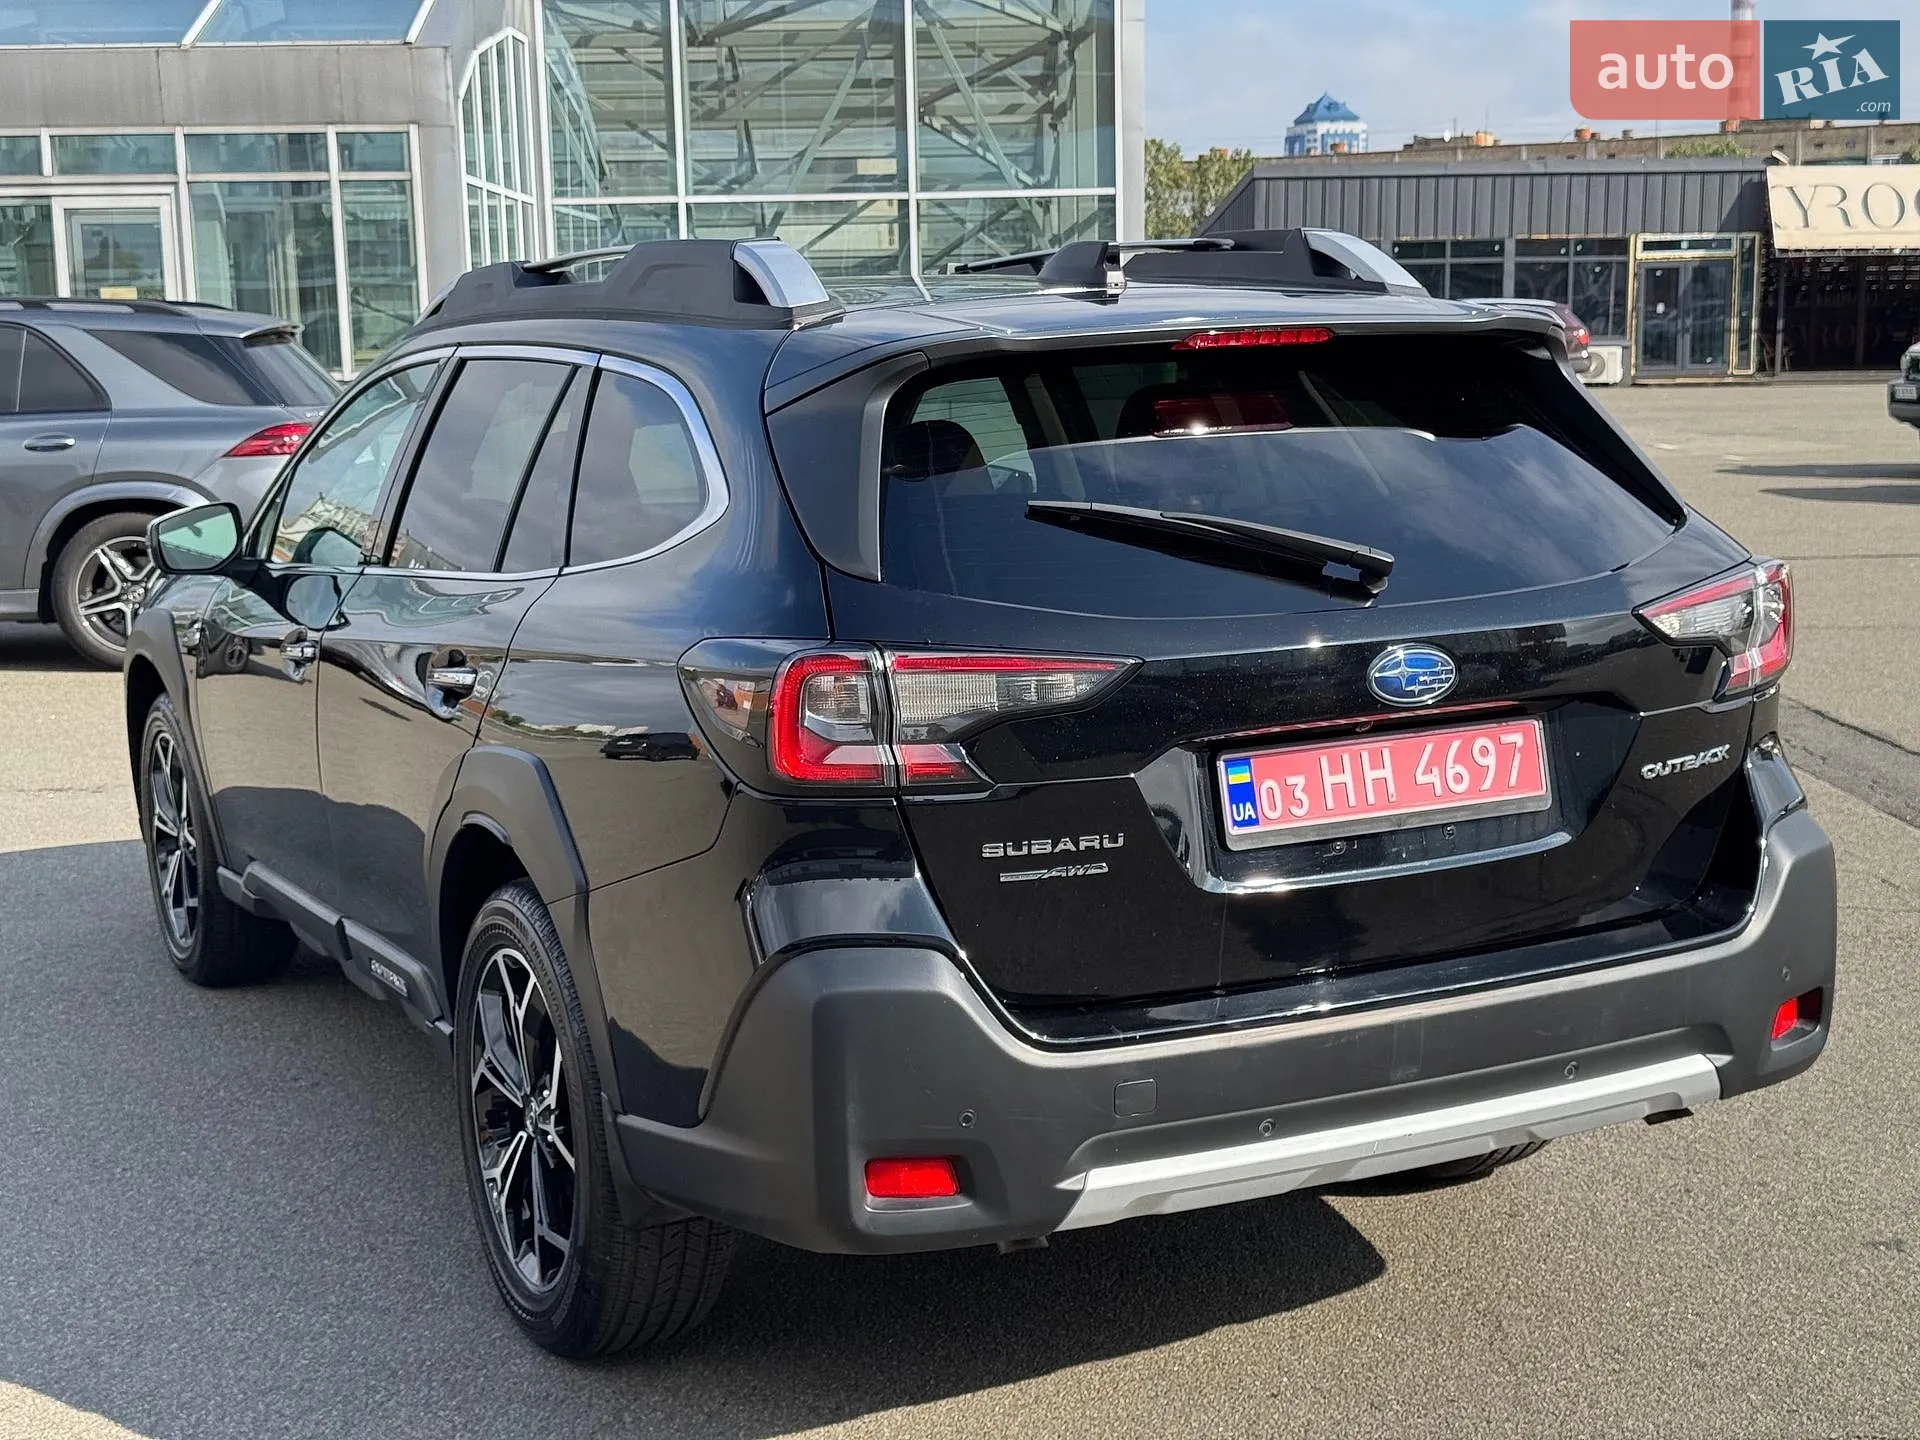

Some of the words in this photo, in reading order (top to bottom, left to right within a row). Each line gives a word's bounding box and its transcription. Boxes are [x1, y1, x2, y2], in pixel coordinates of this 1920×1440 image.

[1258, 773, 1310, 820] 03
[1318, 747, 1397, 810] HH
[1413, 732, 1524, 798] 4697
[1640, 743, 1731, 780] OUTBACK
[1232, 802, 1257, 822] UA
[981, 832, 1125, 858] SUBARU
